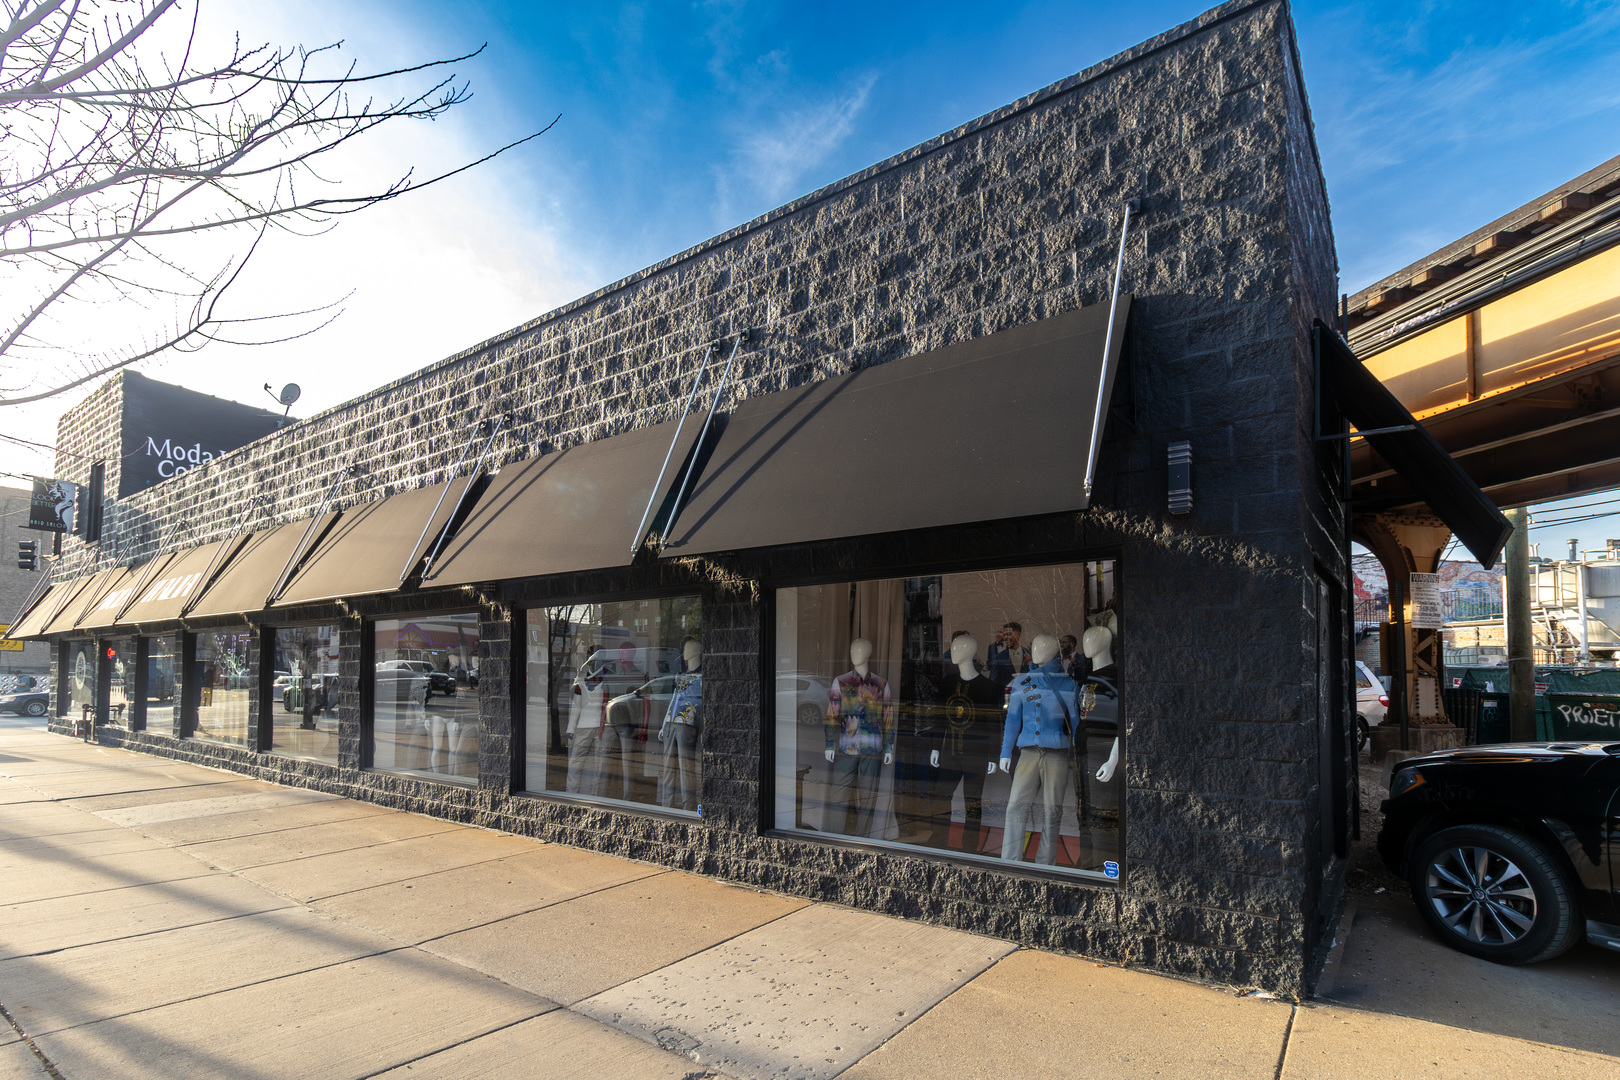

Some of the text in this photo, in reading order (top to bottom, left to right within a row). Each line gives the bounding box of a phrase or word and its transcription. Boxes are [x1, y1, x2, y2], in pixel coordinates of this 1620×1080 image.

[146, 436, 213, 464] Moda
[32, 500, 56, 508] BETTER
[1411, 574, 1440, 583] WARNING
